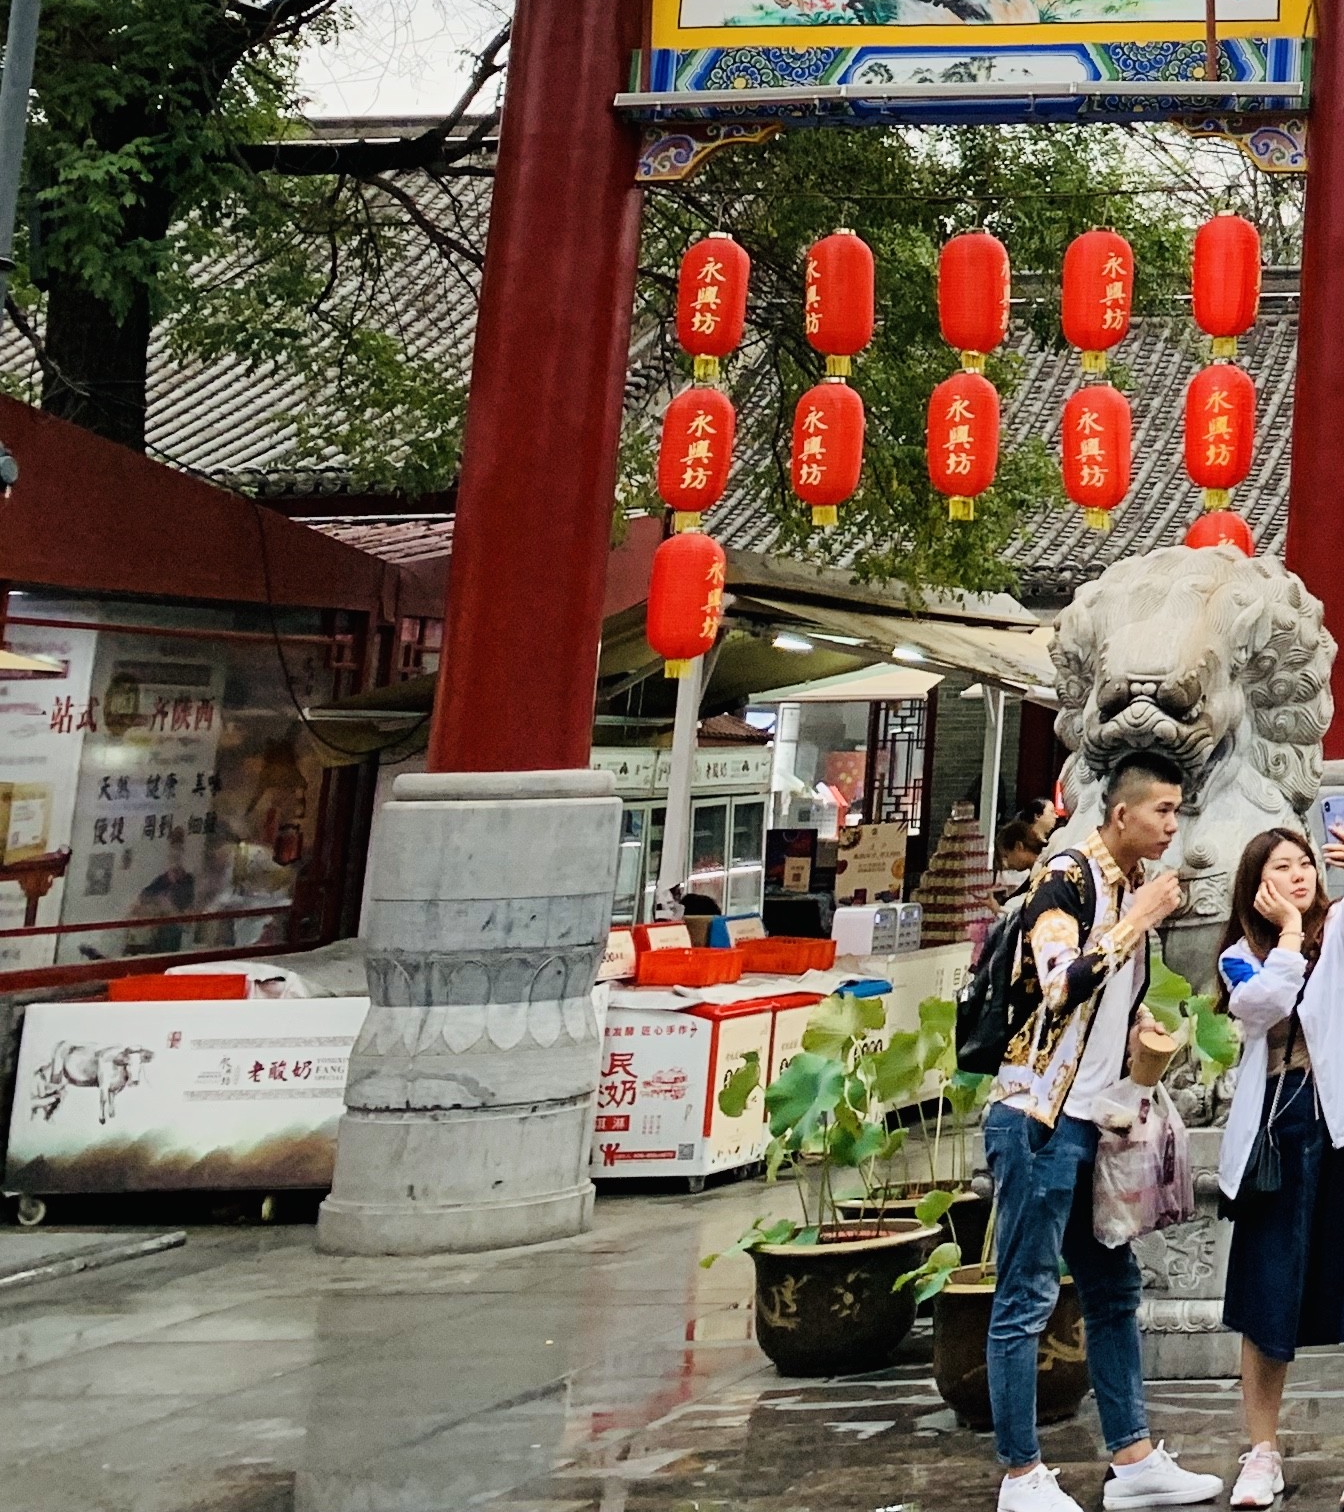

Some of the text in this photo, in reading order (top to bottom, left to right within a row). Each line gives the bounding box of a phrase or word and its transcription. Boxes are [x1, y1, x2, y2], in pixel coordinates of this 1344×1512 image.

[690, 256, 727, 335] 永興坊
[1100, 251, 1128, 332] 永興坊
[680, 409, 718, 490] 永興坊
[798, 405, 829, 486] 永興坊
[942, 394, 976, 476] 永興坊
[1075, 407, 1109, 487] 永興坊
[1203, 385, 1236, 467] 永興坊
[247, 1059, 313, 1083] 老酸奶
[641, 1025, 688, 1037] 匠心手作
